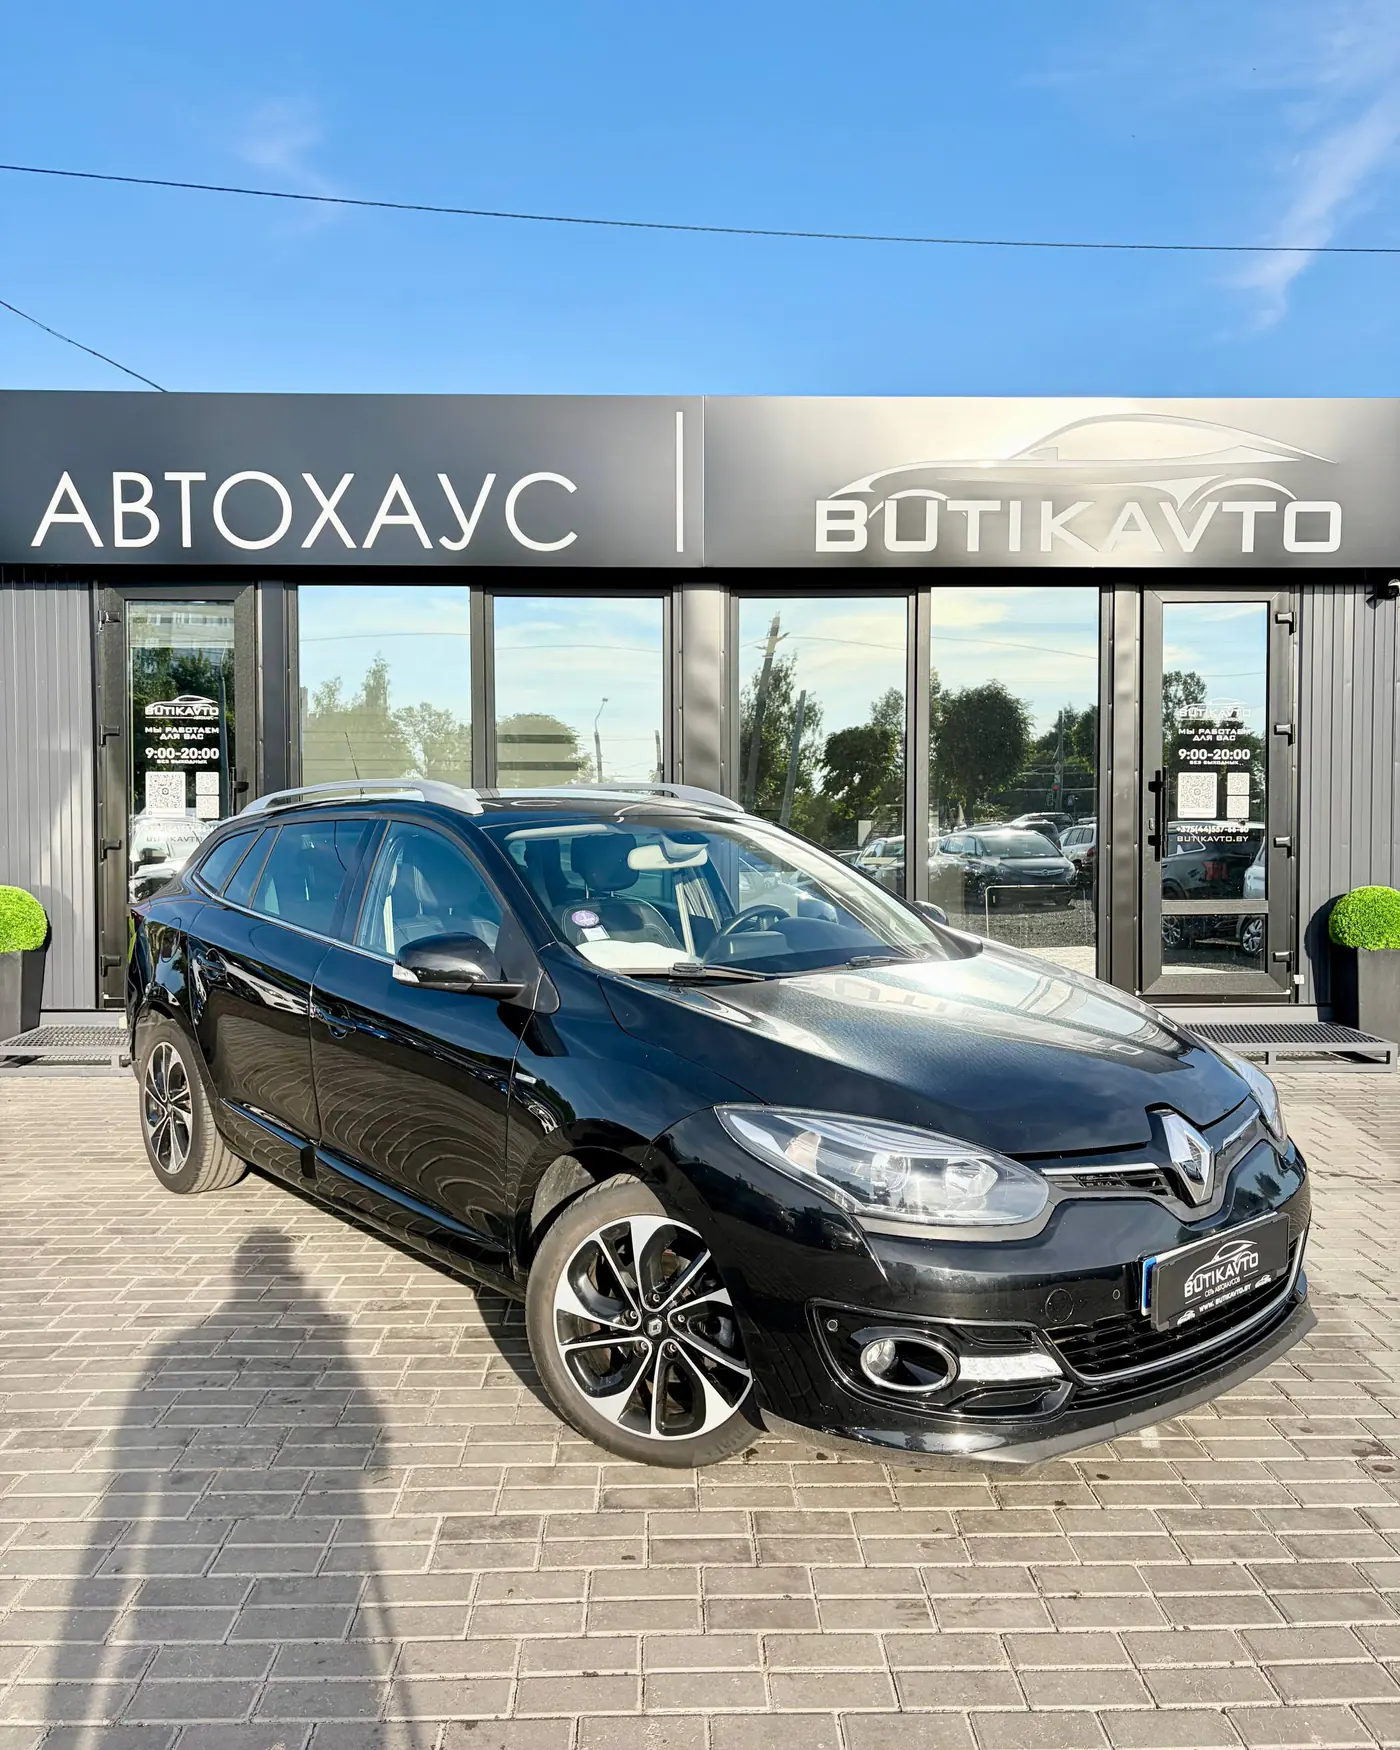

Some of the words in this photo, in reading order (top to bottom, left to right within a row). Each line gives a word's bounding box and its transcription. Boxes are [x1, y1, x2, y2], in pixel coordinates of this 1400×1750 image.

[31, 470, 578, 552] АВТОХАУС
[815, 499, 1342, 552] BUTIKAVTO
[144, 705, 219, 716] BUTIKAVTO
[1179, 707, 1251, 718] BUTIKAVTO
[144, 726, 162, 734] МЫ
[165, 726, 220, 734] РАБОТАЕМ
[1192, 734, 1213, 742] ДЛЯ
[144, 747, 220, 760] 9:00-20:00
[1178, 748, 1251, 761] 9:00-20:00
[1177, 835, 1249, 843] BUTIKAVTO.BY
[1184, 1252, 1259, 1298] BUTIKAVTO
